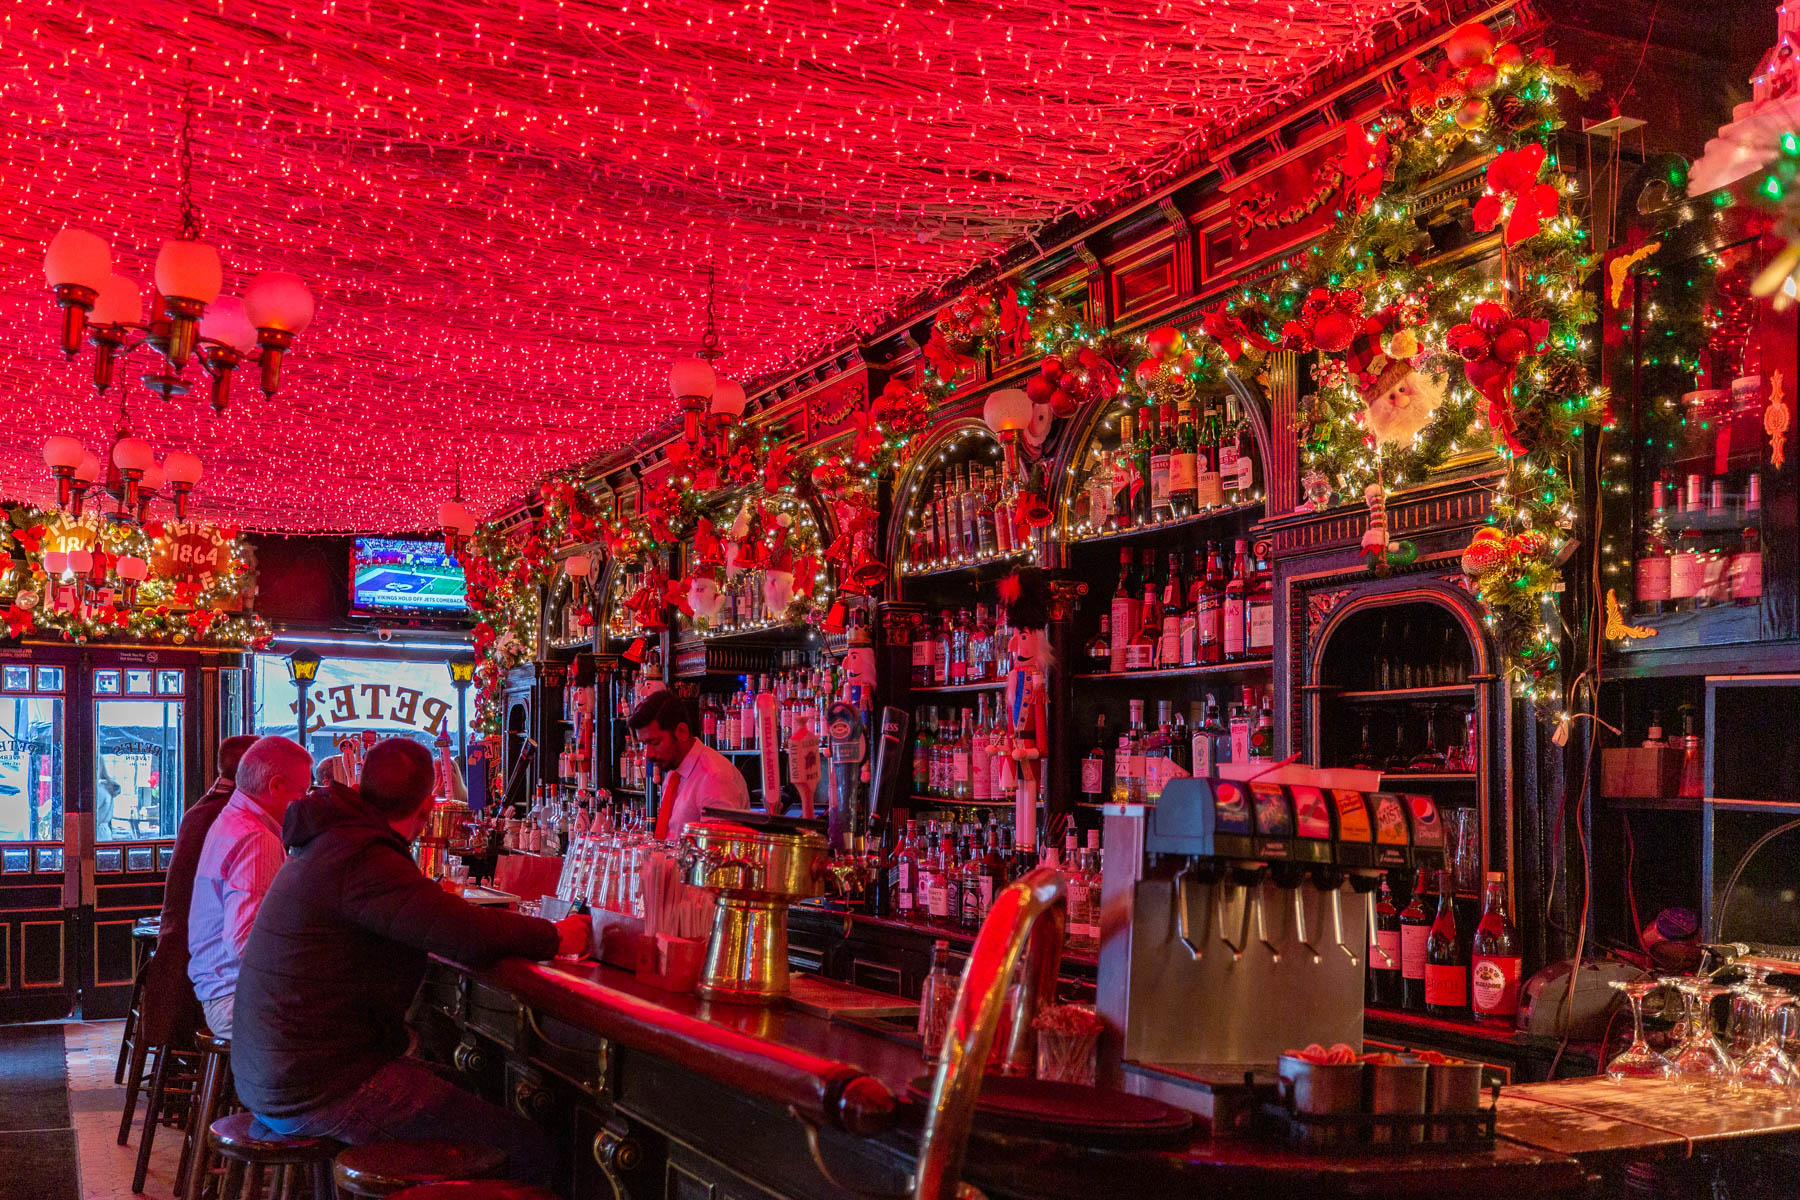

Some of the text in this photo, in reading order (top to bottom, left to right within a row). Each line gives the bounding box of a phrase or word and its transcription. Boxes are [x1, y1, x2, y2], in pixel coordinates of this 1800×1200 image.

[169, 543, 218, 566] 1864
[764, 717, 776, 790] STELLA ARTOIS
